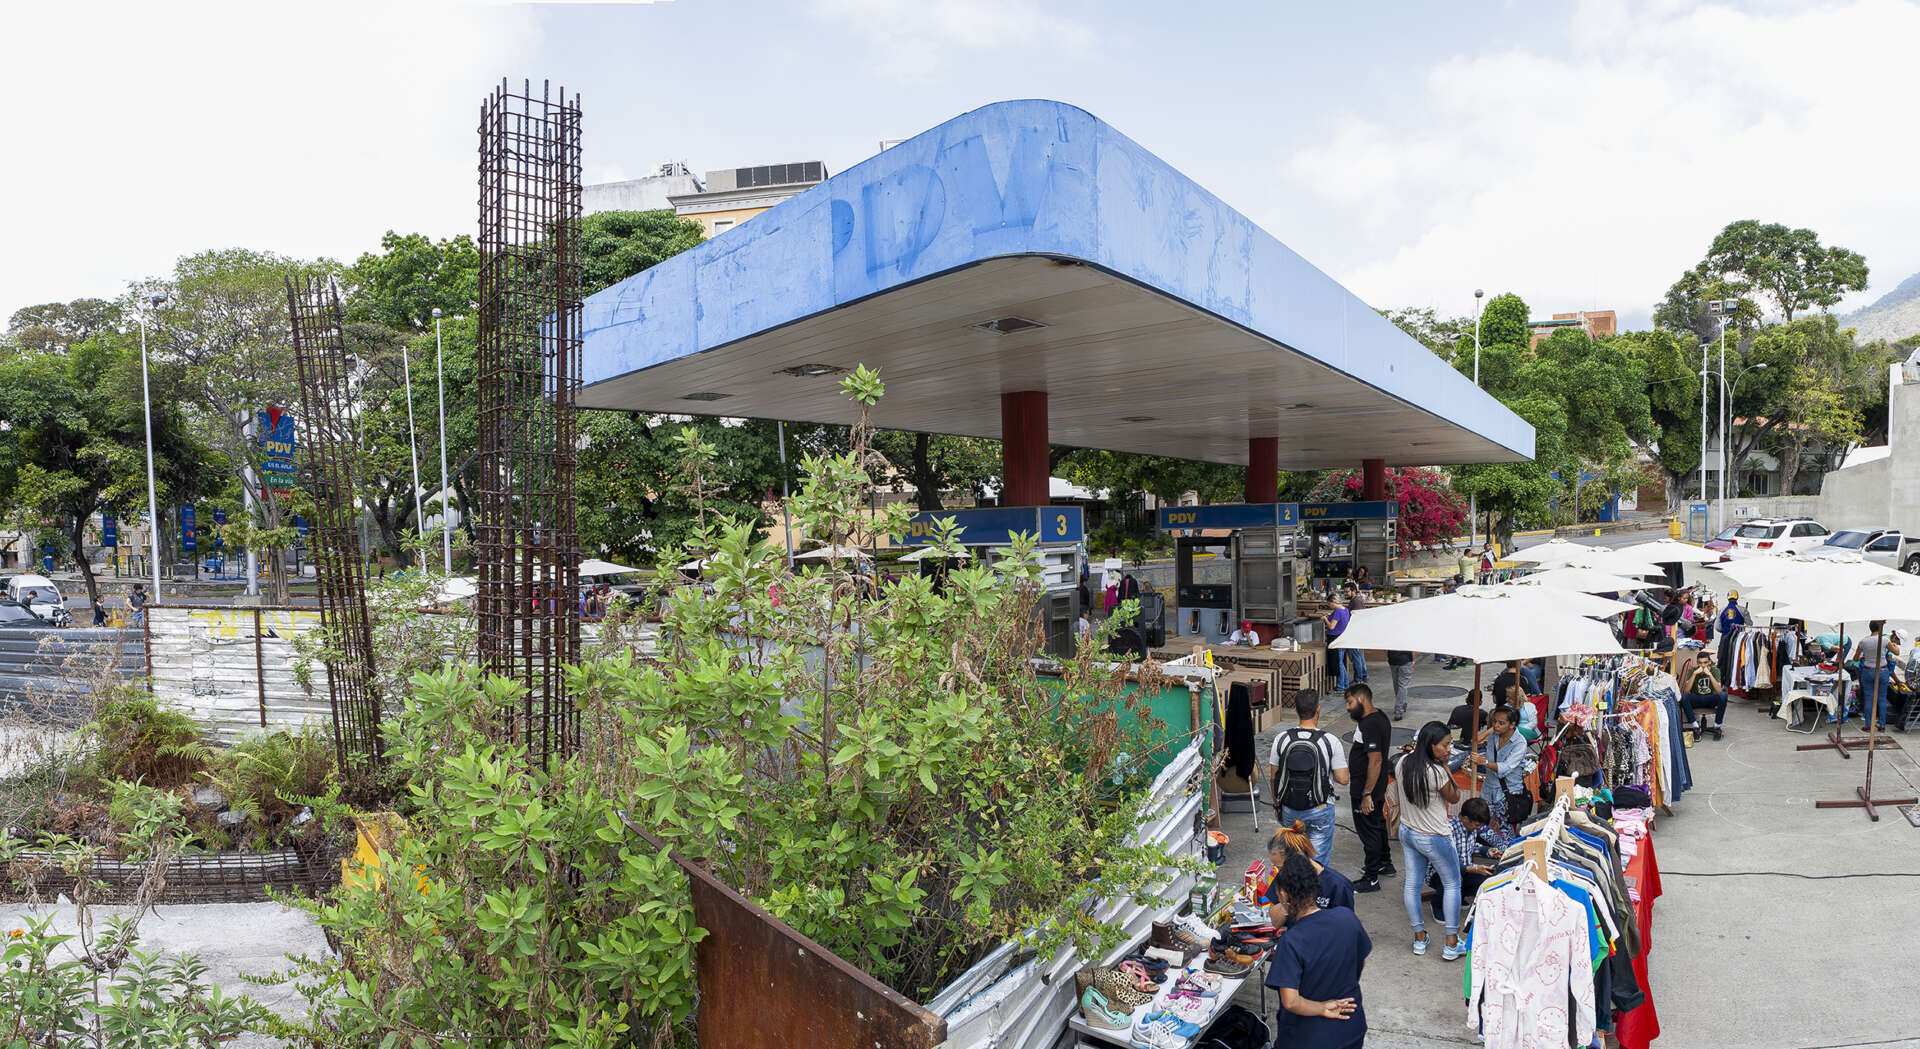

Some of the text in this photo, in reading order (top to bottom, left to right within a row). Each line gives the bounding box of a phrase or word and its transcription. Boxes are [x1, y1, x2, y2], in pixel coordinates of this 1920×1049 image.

[266, 440, 292, 454] PDV
[1168, 512, 1197, 524] PDV
[1284, 508, 1291, 521] 2
[1304, 507, 1327, 516] PDV
[1056, 514, 1067, 536] 3
